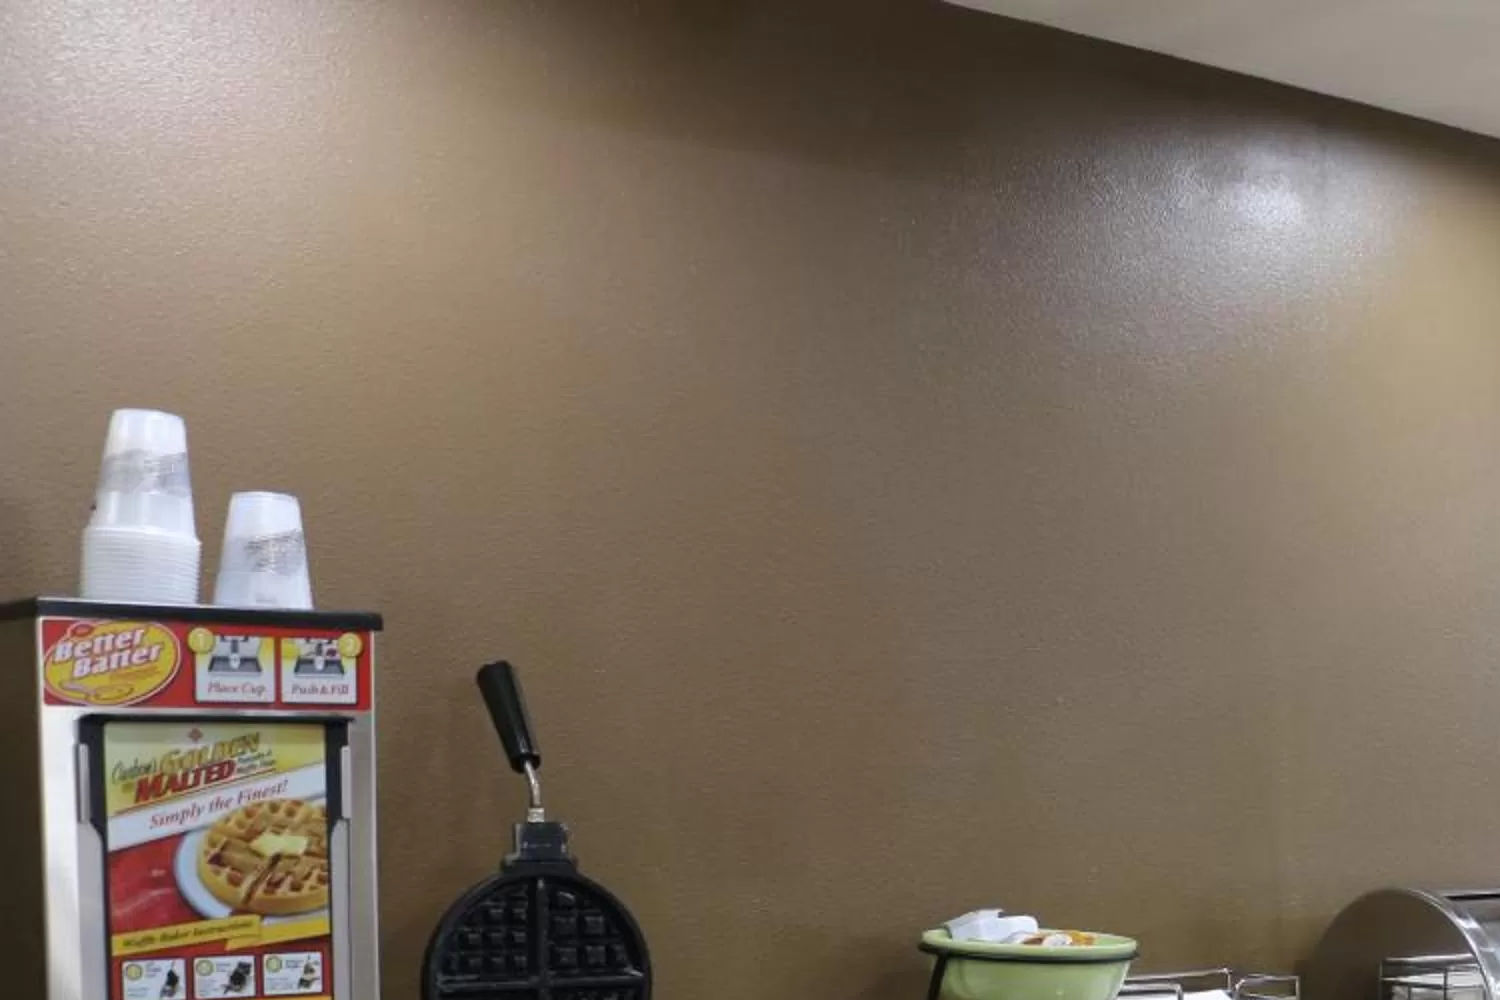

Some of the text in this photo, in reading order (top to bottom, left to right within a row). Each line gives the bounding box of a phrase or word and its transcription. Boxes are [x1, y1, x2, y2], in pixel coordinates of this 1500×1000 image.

[53, 629, 146, 664] Better
[71, 643, 164, 680] Batter
[133, 758, 237, 805] MALTED
[150, 801, 205, 830] Simply
[207, 793, 234, 813] the
